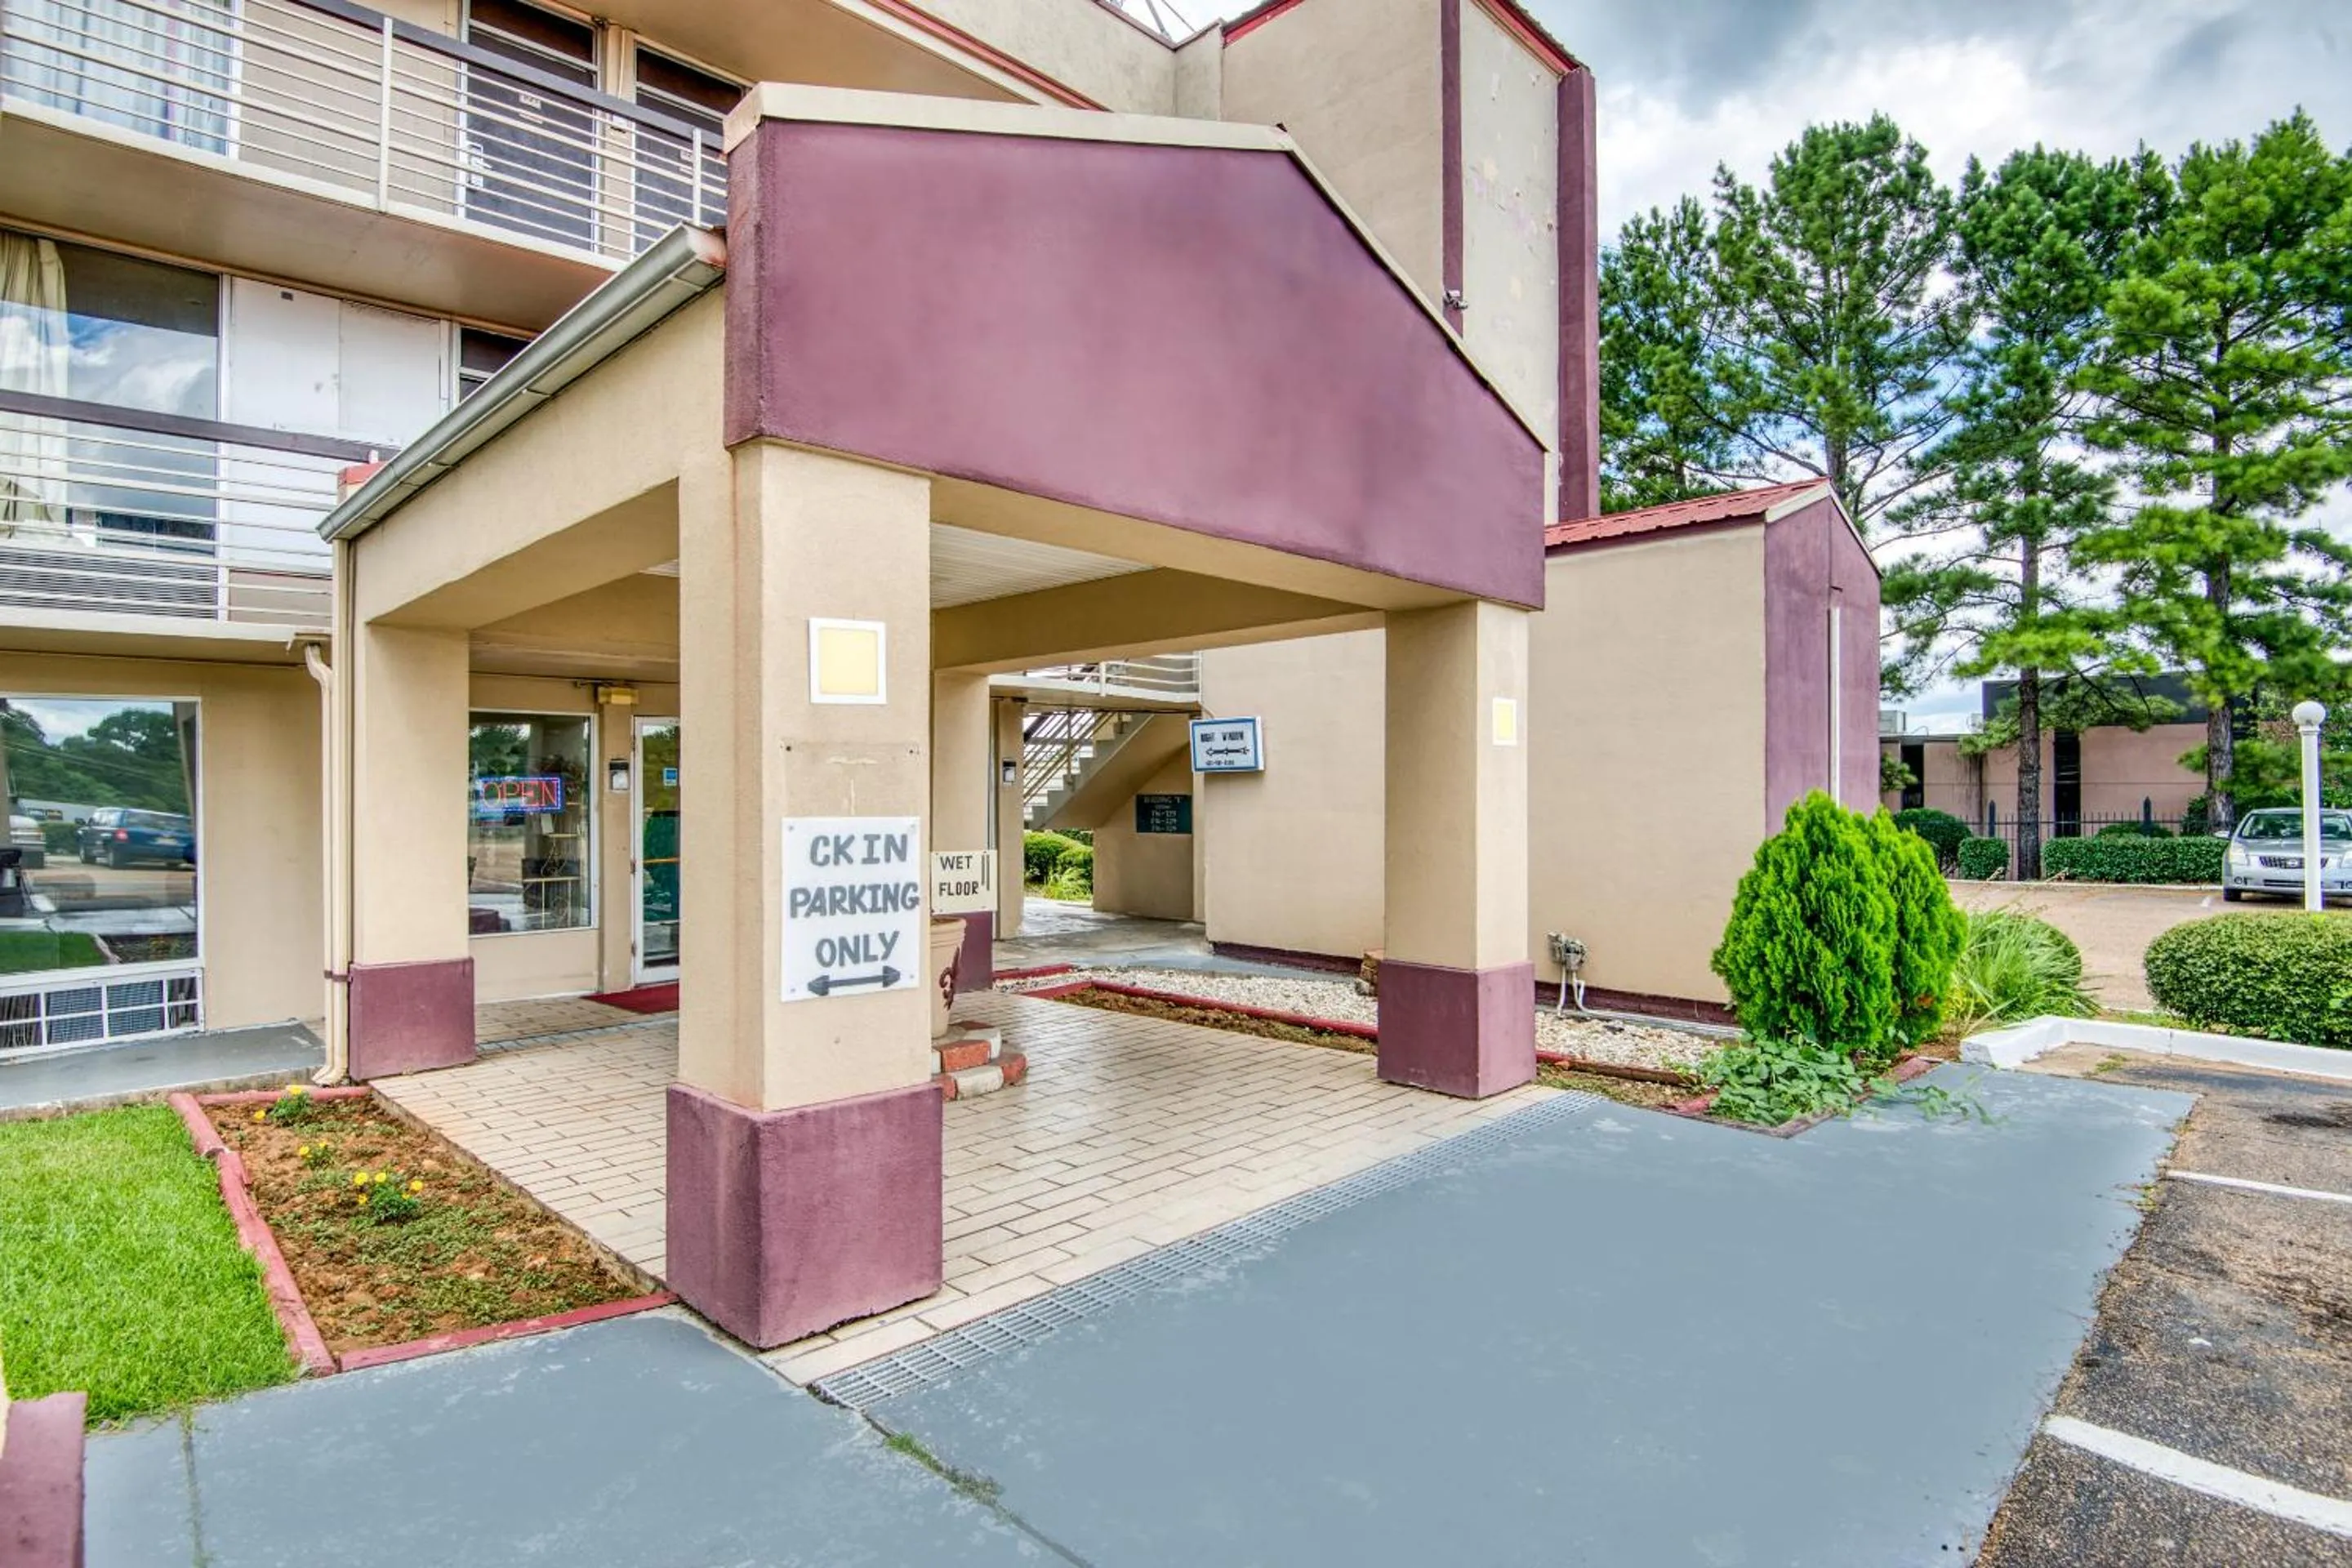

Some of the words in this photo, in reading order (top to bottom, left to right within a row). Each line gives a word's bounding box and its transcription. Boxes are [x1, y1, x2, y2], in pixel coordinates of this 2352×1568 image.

[483, 781, 557, 808] OPEN
[940, 855, 973, 871] WET
[790, 882, 920, 918] PARKING
[939, 880, 979, 898] FLOOR
[815, 931, 900, 968] ONLY
